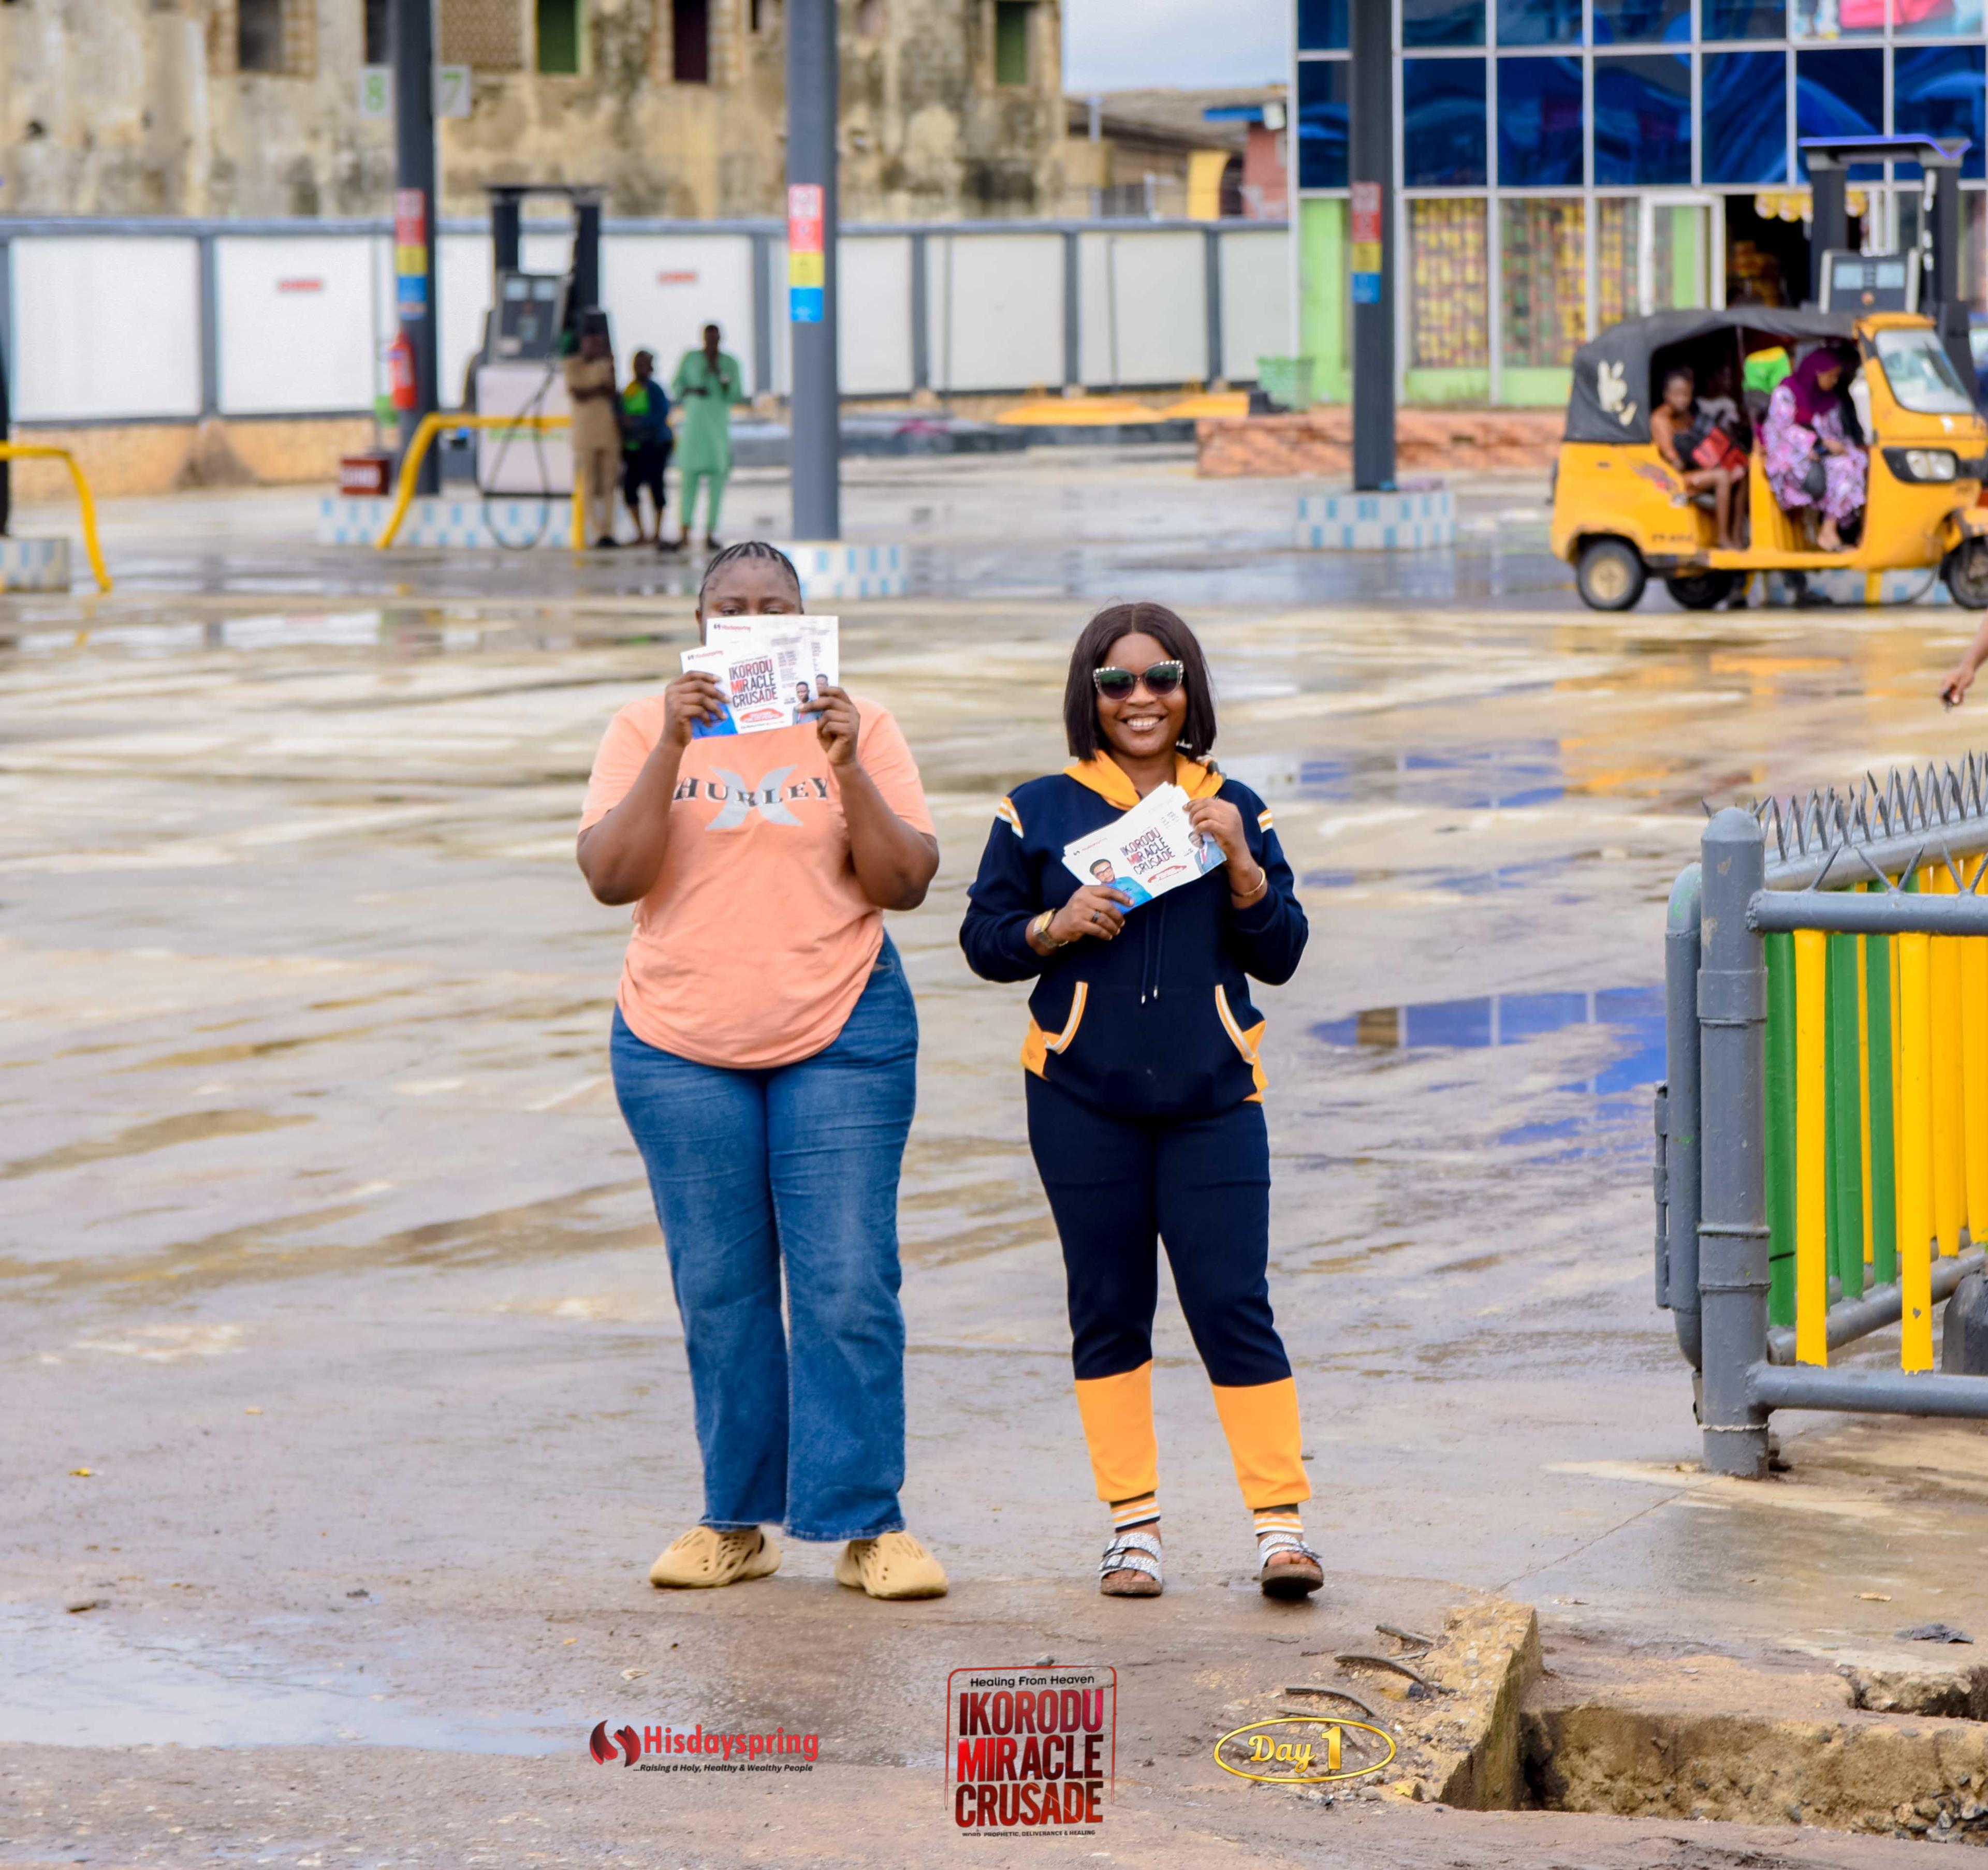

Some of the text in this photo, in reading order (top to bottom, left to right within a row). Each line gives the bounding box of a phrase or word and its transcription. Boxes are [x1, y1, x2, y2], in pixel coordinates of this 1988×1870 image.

[442, 72, 462, 112] 7
[729, 659, 772, 680] IKORODU
[730, 672, 776, 695] MIRACLE
[732, 687, 778, 708] CRUSADE
[674, 777, 828, 807] HURLEY
[1120, 827, 1161, 857] IKORODU
[1127, 837, 1168, 865] MIRACLE
[1133, 847, 1176, 875] CRUSADE
